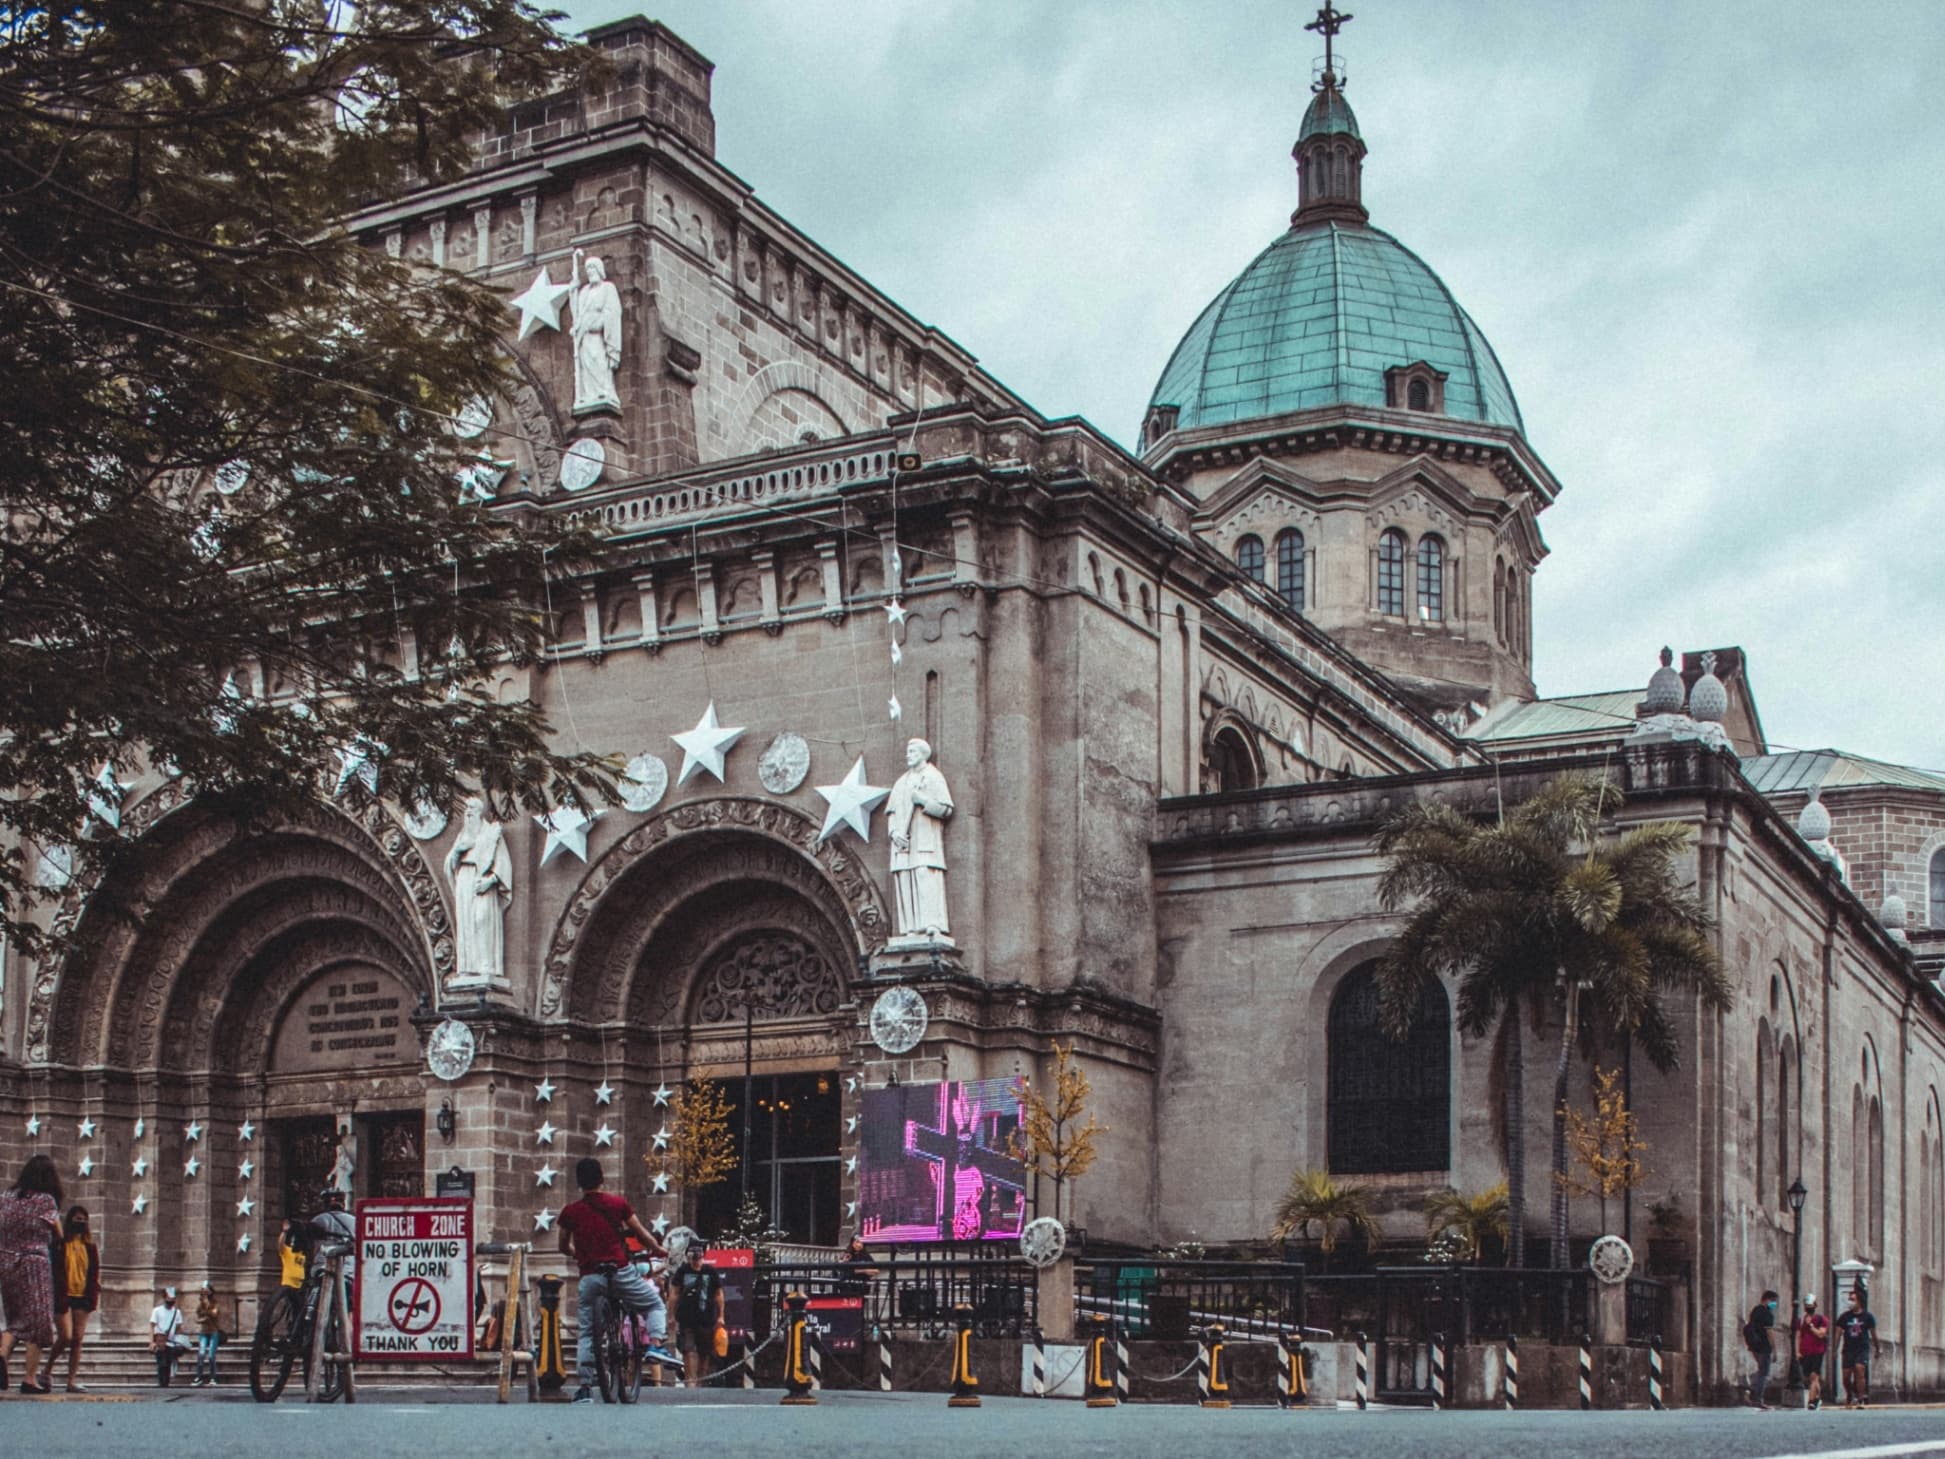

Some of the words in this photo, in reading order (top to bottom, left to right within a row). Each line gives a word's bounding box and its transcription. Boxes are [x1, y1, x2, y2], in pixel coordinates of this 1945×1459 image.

[365, 1216, 414, 1237] CHURCH
[431, 1215, 465, 1236] ZONE
[366, 1243, 385, 1259] NO
[391, 1241, 460, 1258] BLOWING
[382, 1263, 400, 1277] OF
[408, 1262, 448, 1277] HORN
[366, 1336, 418, 1351] THANK
[428, 1335, 459, 1351] YOU
